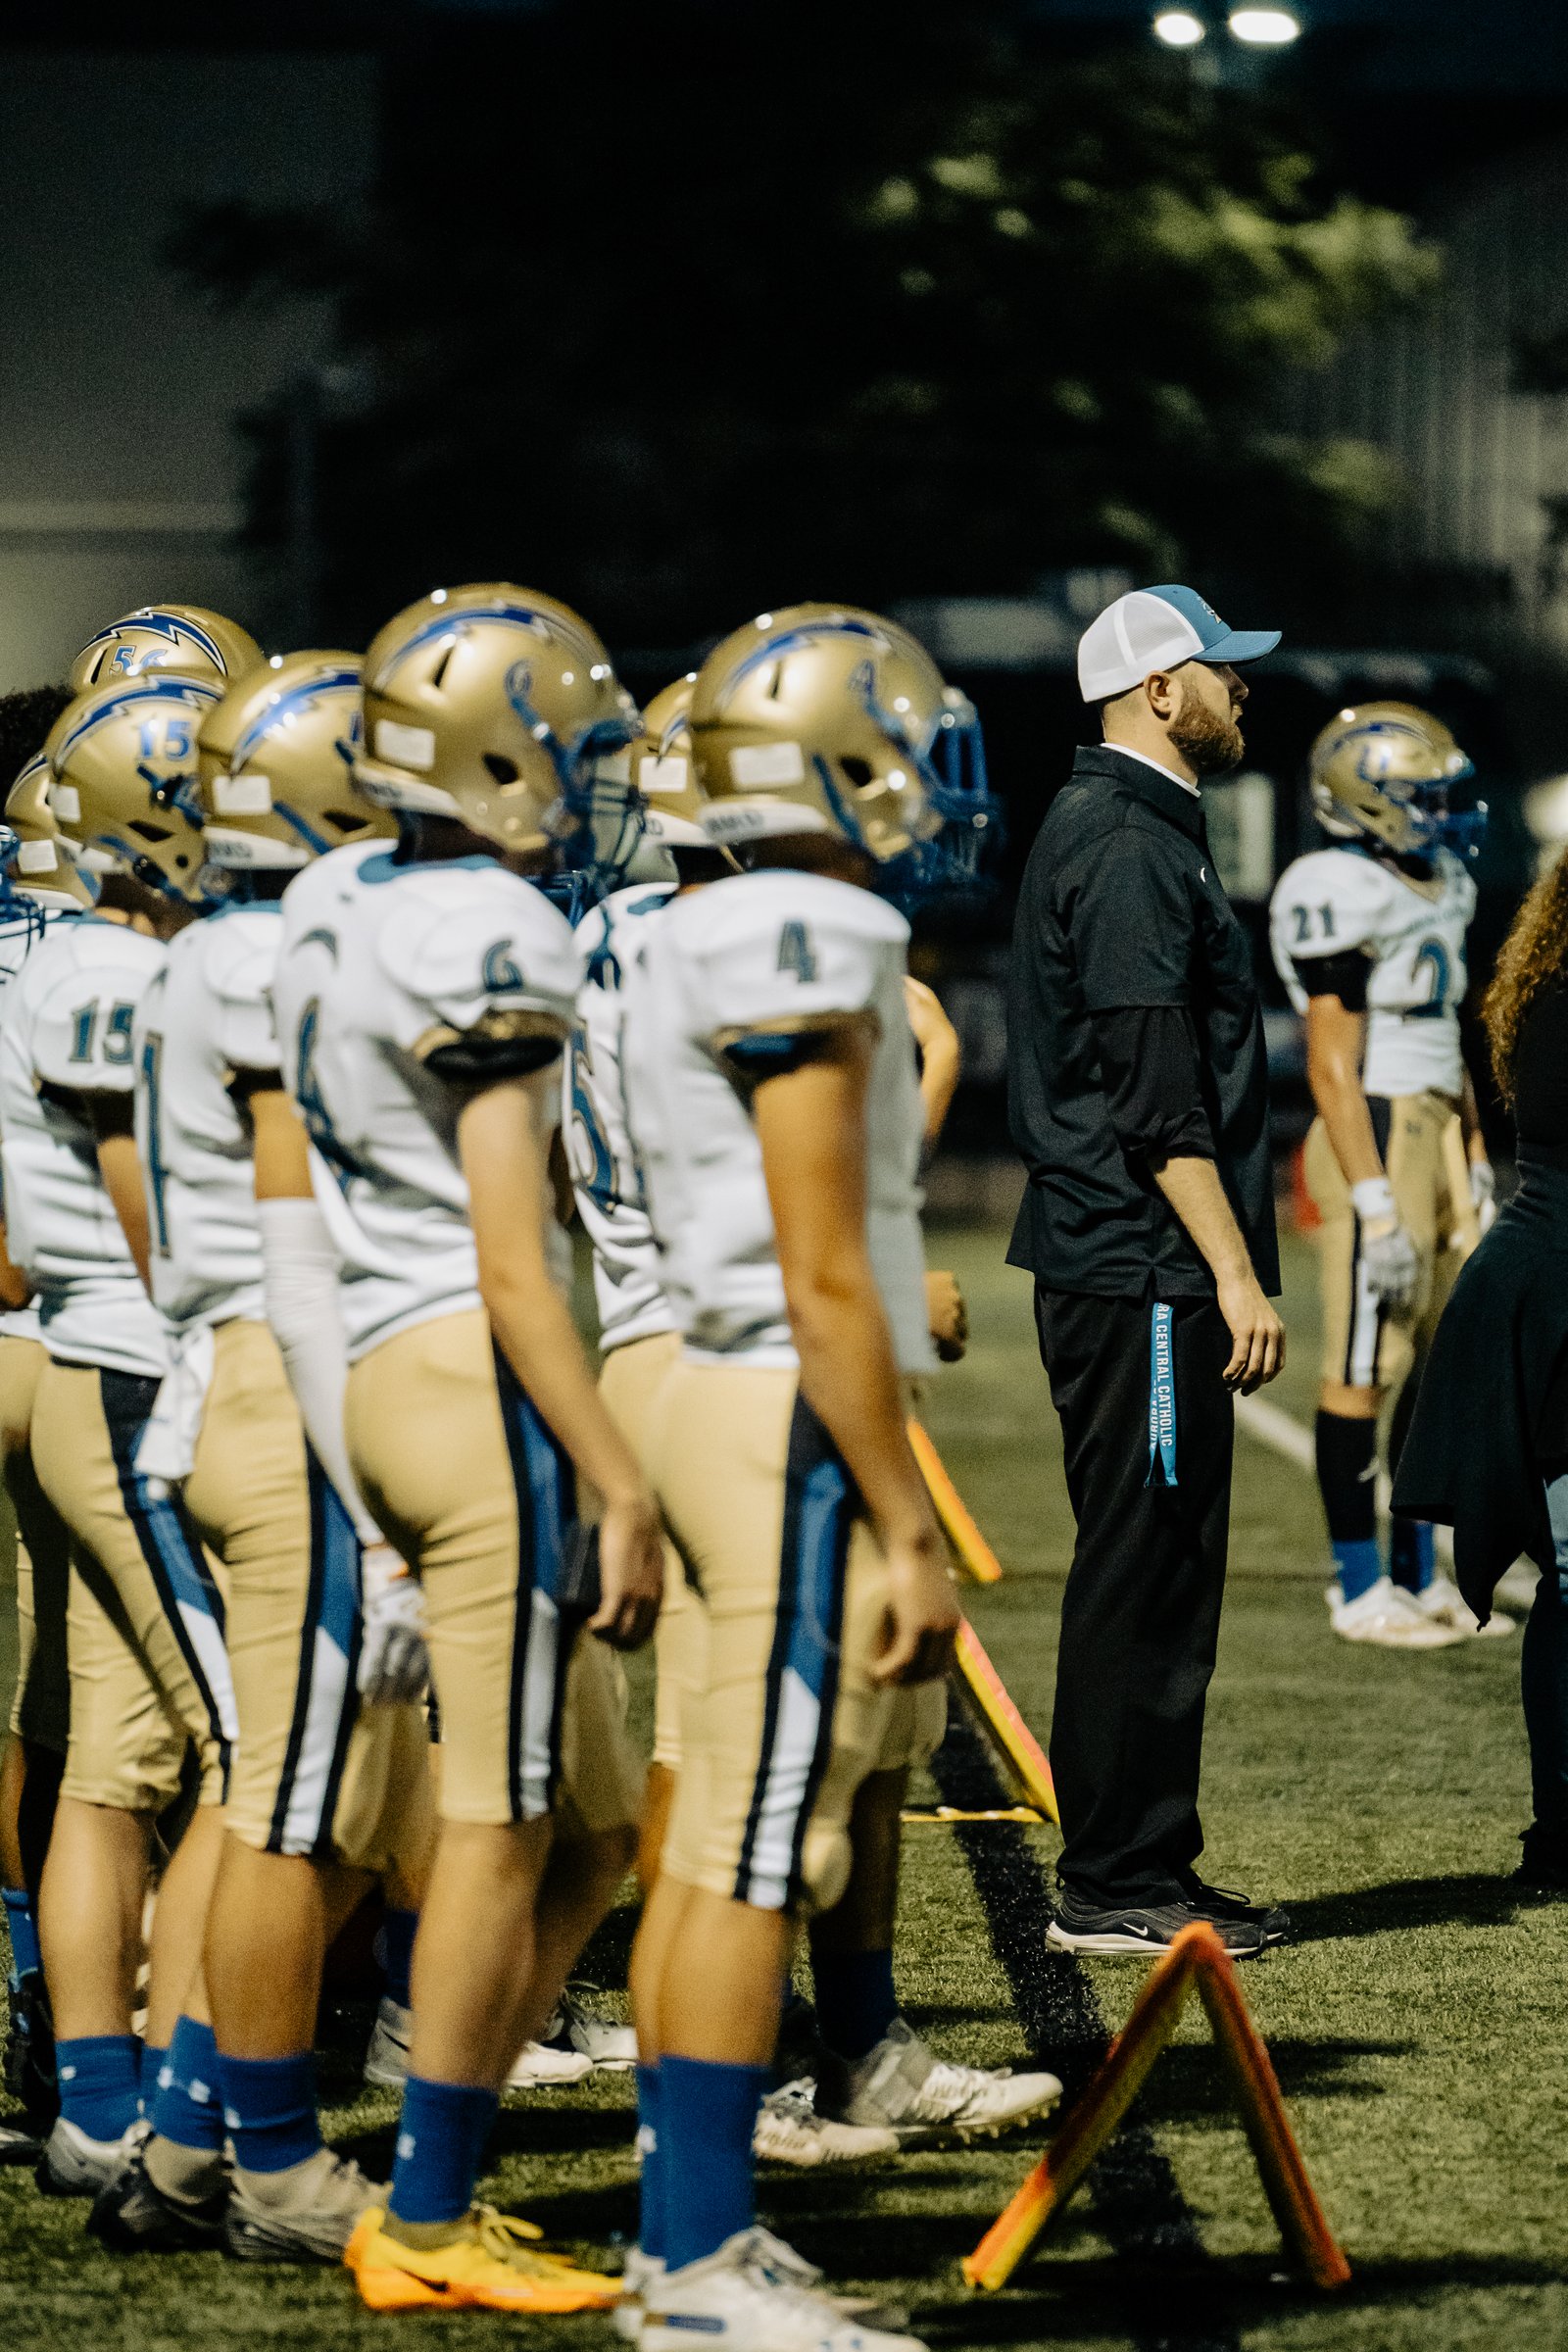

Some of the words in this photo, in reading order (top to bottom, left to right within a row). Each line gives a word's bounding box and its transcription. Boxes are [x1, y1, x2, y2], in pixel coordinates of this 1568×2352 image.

[135, 716, 192, 761] 15
[778, 919, 815, 983] 4
[1292, 904, 1335, 942] 21
[481, 938, 524, 995] 6
[68, 997, 135, 1064] 15
[1156, 1302, 1170, 1321] RA
[1155, 1324, 1169, 1383] CENTRAL
[1157, 1385, 1173, 1446] CATHOLIC
